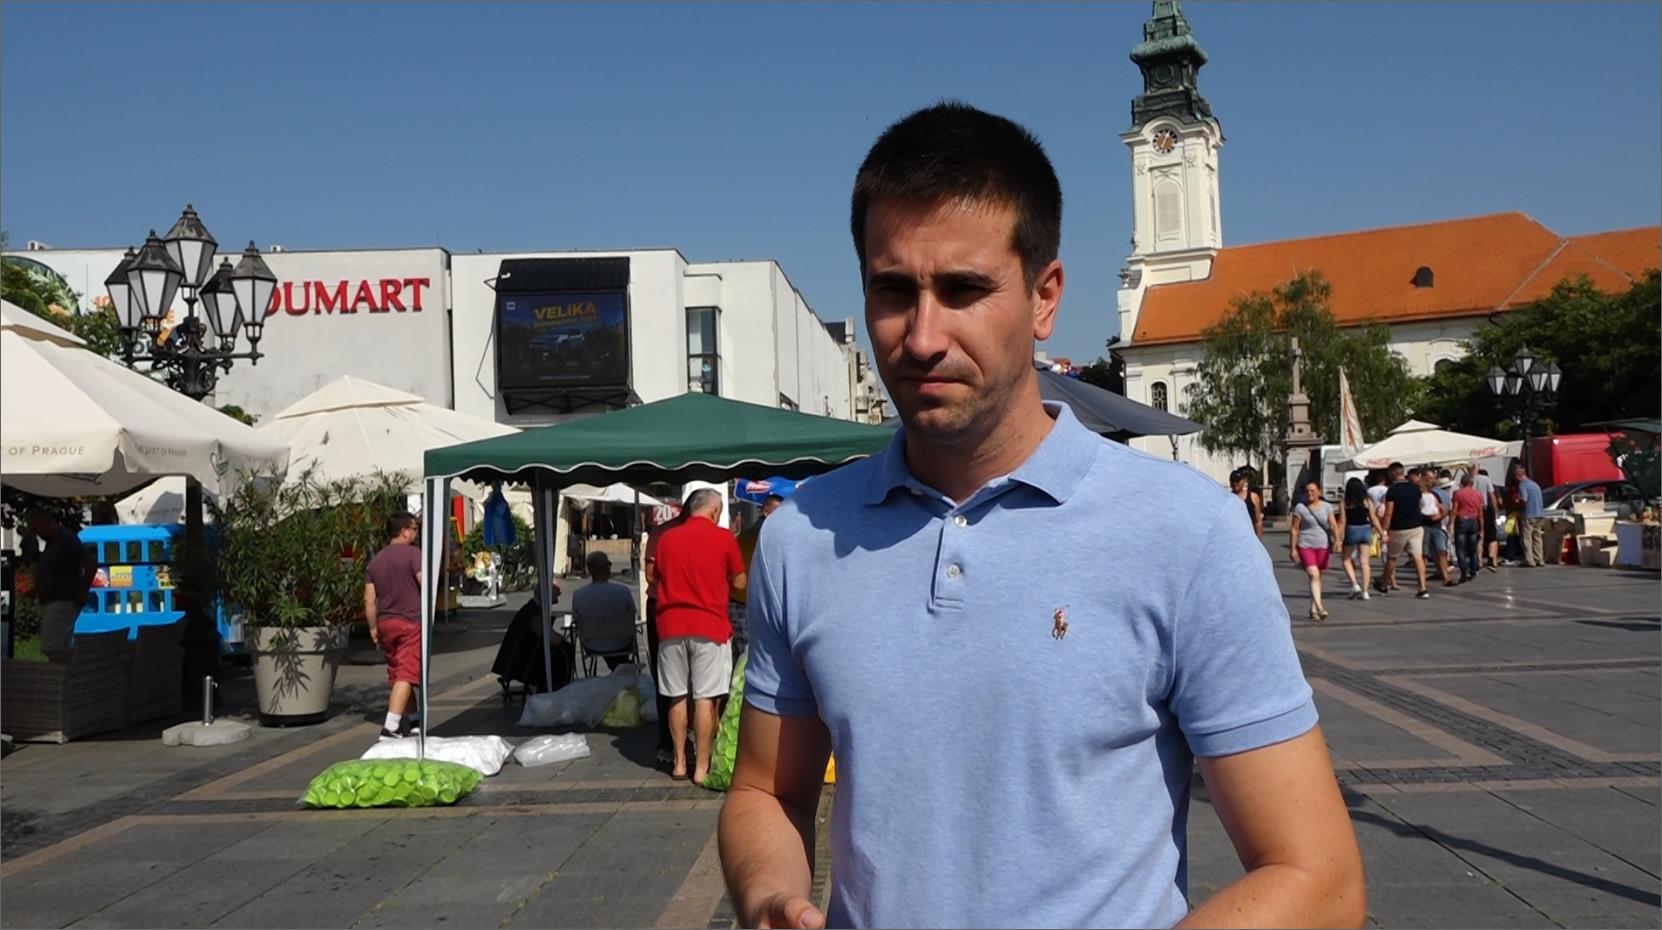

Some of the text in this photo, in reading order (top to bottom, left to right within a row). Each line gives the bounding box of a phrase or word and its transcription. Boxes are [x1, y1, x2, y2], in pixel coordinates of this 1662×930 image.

[533, 302, 597, 320] VELIKA
[8, 444, 86, 456] OF PRAGUE
